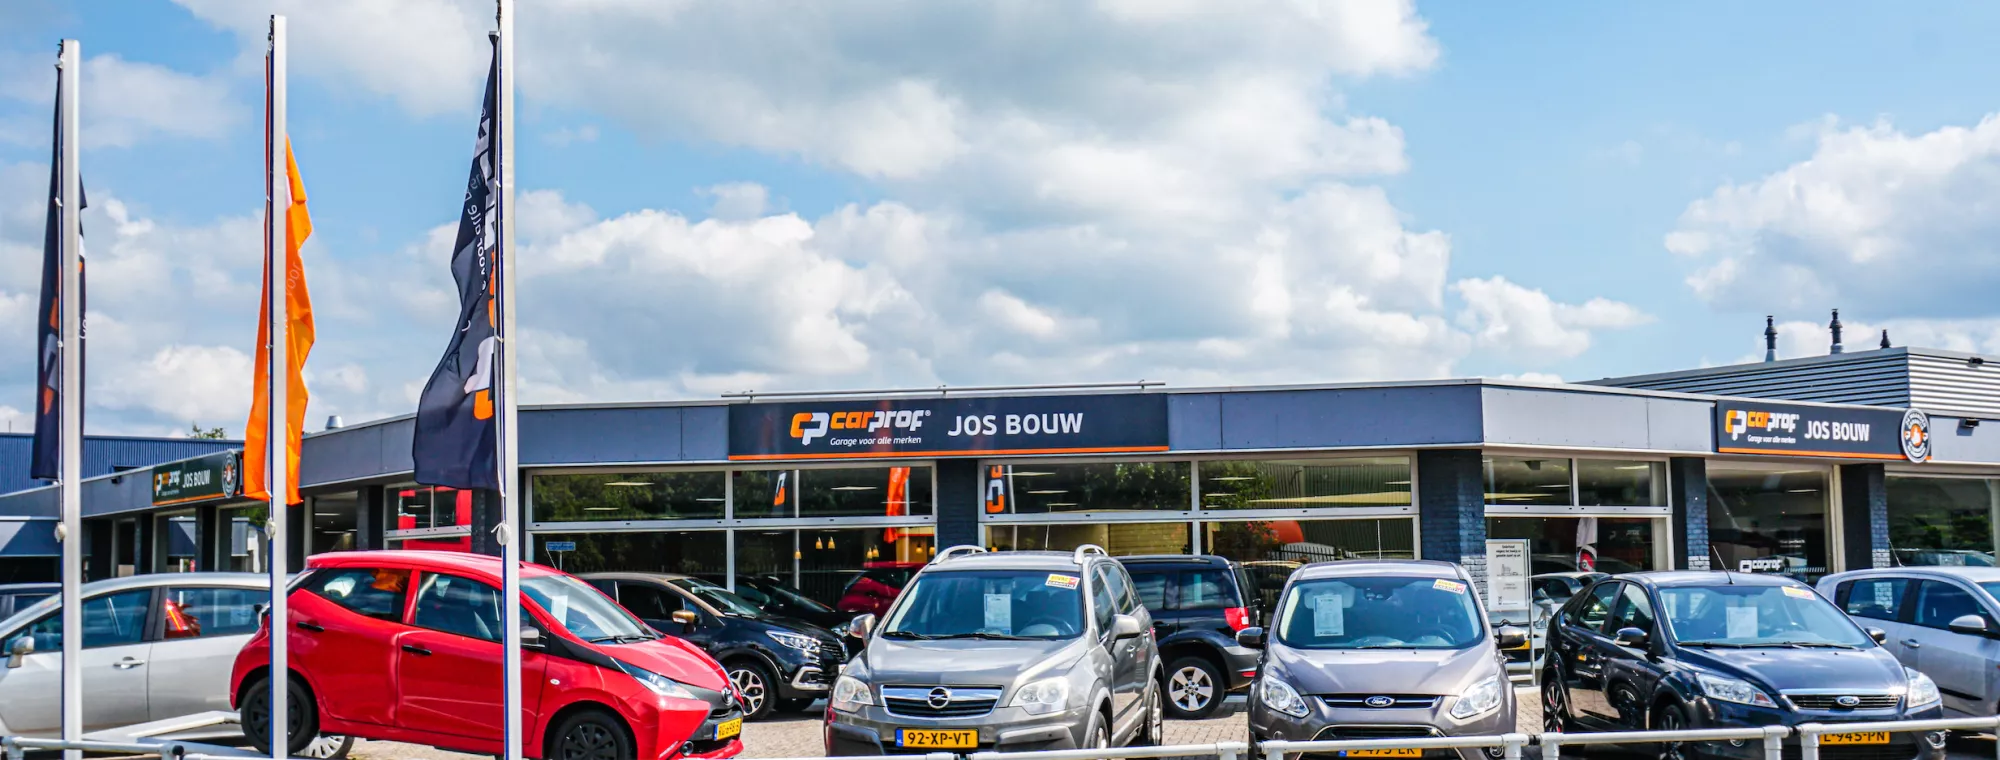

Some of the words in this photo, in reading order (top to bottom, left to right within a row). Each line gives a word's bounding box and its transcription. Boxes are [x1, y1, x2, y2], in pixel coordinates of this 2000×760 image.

[947, 415, 998, 436] JOS
[1005, 412, 1083, 434] BOUW
[1804, 421, 1830, 439] JOS
[1832, 422, 1870, 441] BOUW
[830, 437, 857, 447] Garage
[877, 436, 891, 445] alle
[893, 436, 922, 445] merken
[182, 472, 193, 488] JOS
[194, 469, 211, 487] BOUW
[908, 732, 971, 745] 92-XP-VT
